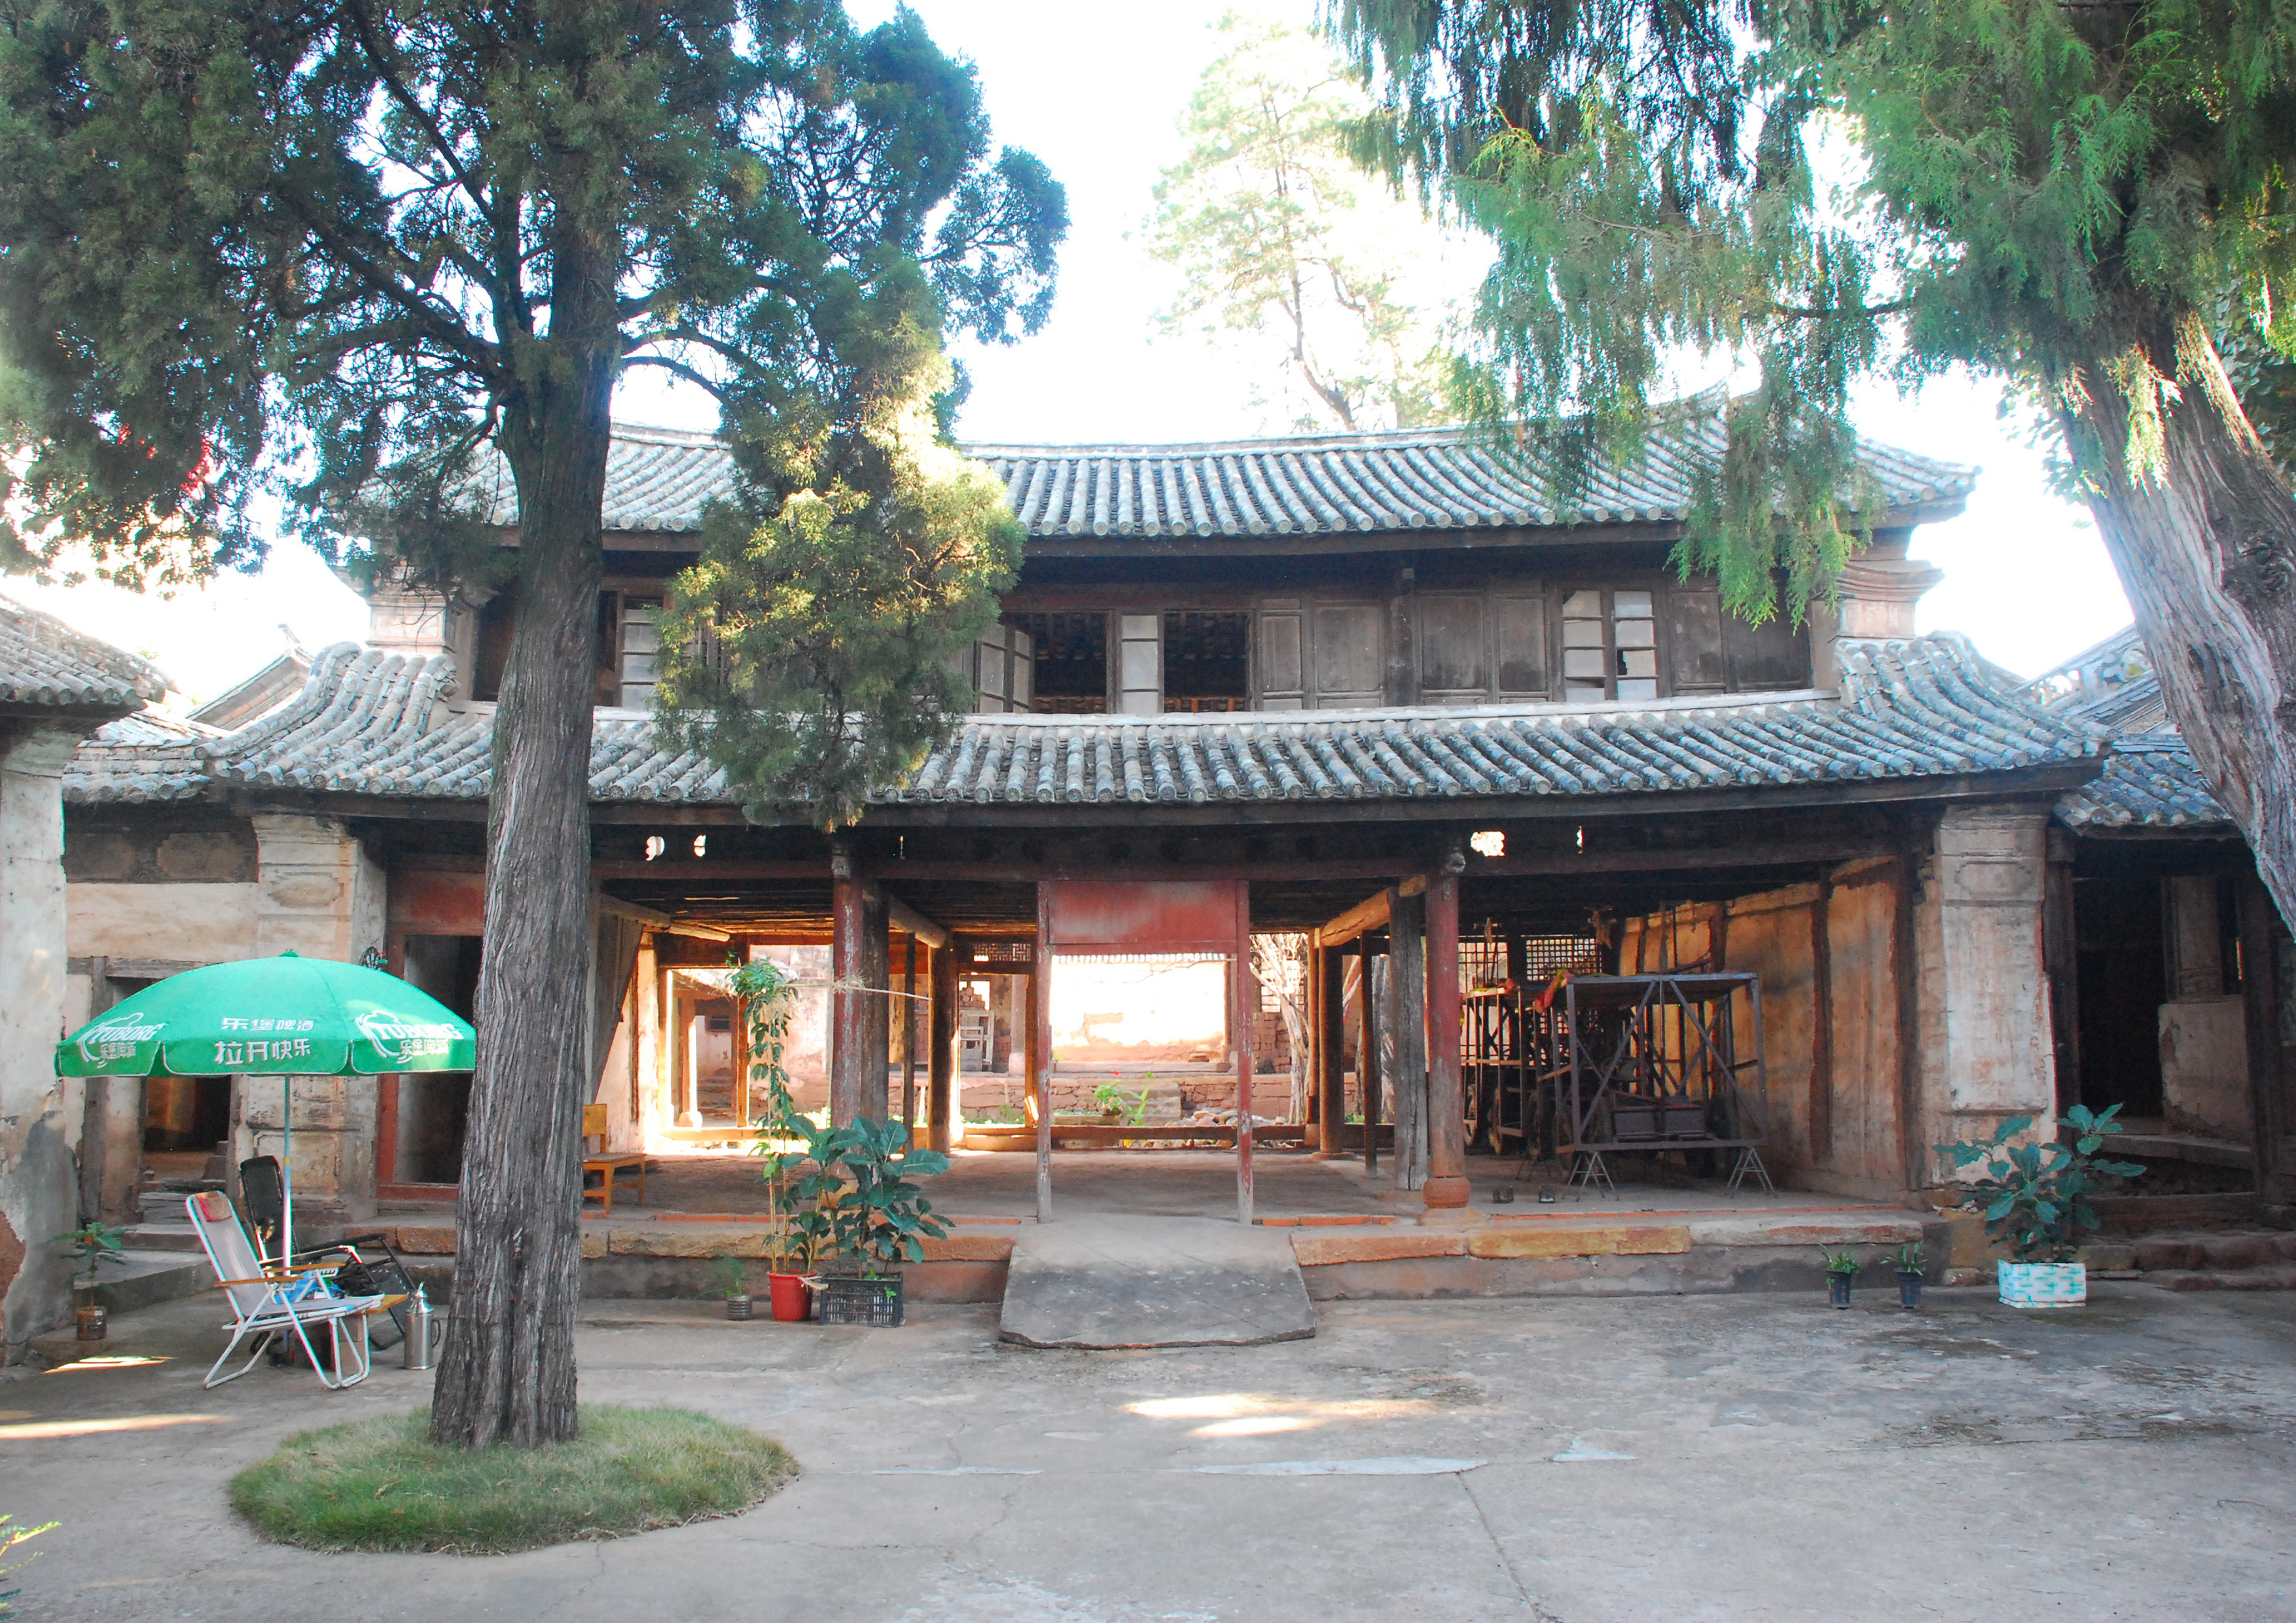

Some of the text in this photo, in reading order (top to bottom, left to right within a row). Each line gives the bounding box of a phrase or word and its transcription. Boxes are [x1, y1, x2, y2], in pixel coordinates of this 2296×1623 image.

[87, 1022, 167, 1044] TUBORG
[221, 1017, 315, 1031] 乐堡啤酒
[367, 1022, 465, 1040] TUBORG
[214, 1037, 312, 1065] 拉开快乐
